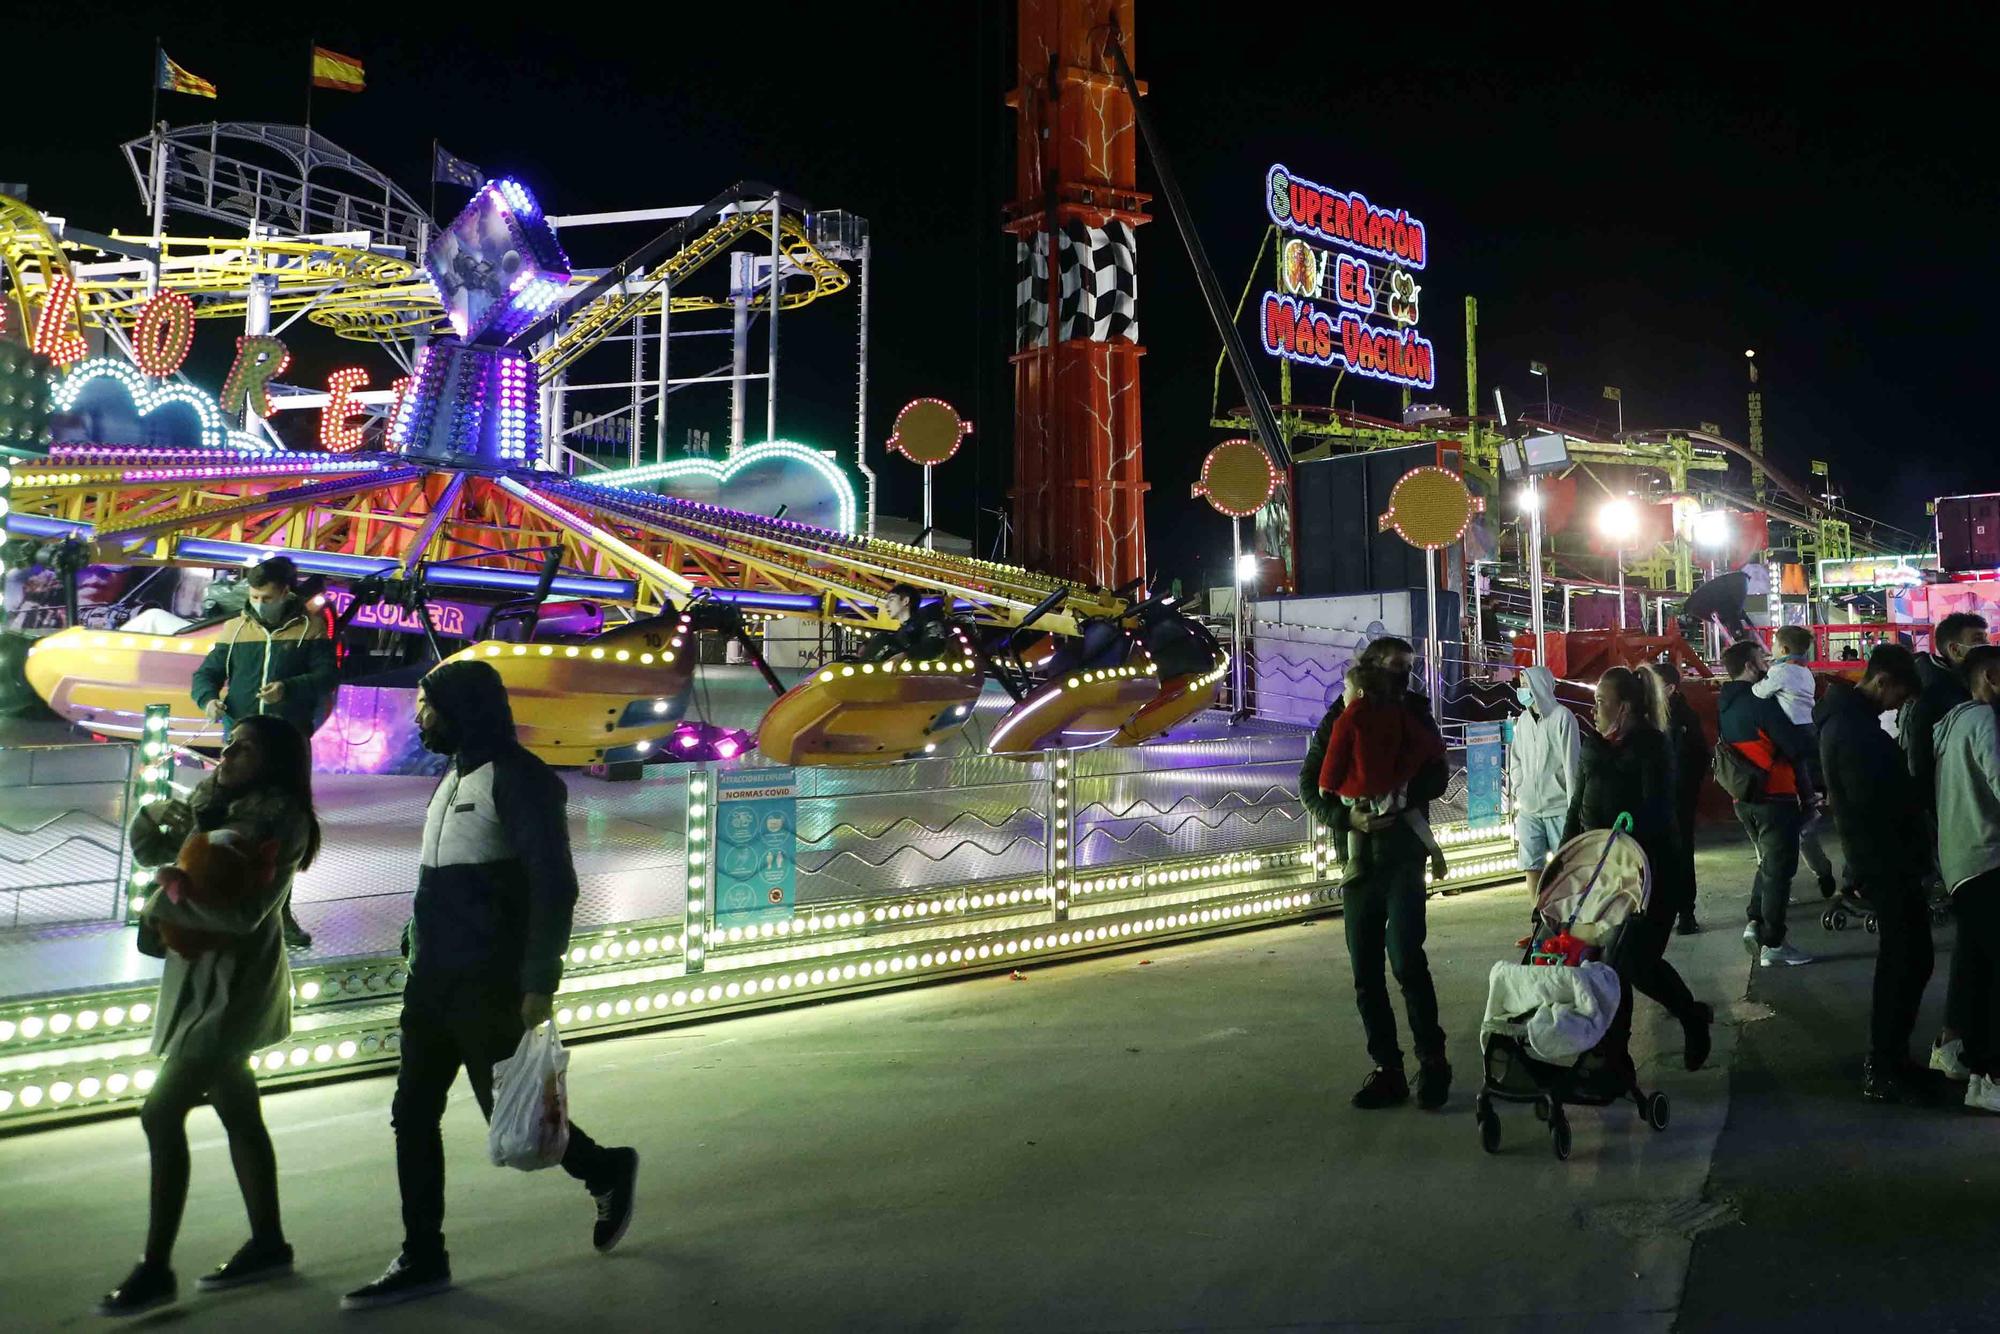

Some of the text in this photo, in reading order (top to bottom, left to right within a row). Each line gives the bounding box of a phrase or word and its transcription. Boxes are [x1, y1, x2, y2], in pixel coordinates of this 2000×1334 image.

[1338, 257, 1373, 307] EL
[1265, 298, 1432, 384] MÁS VACILÓN
[726, 788, 790, 799] NORMAS COVID
